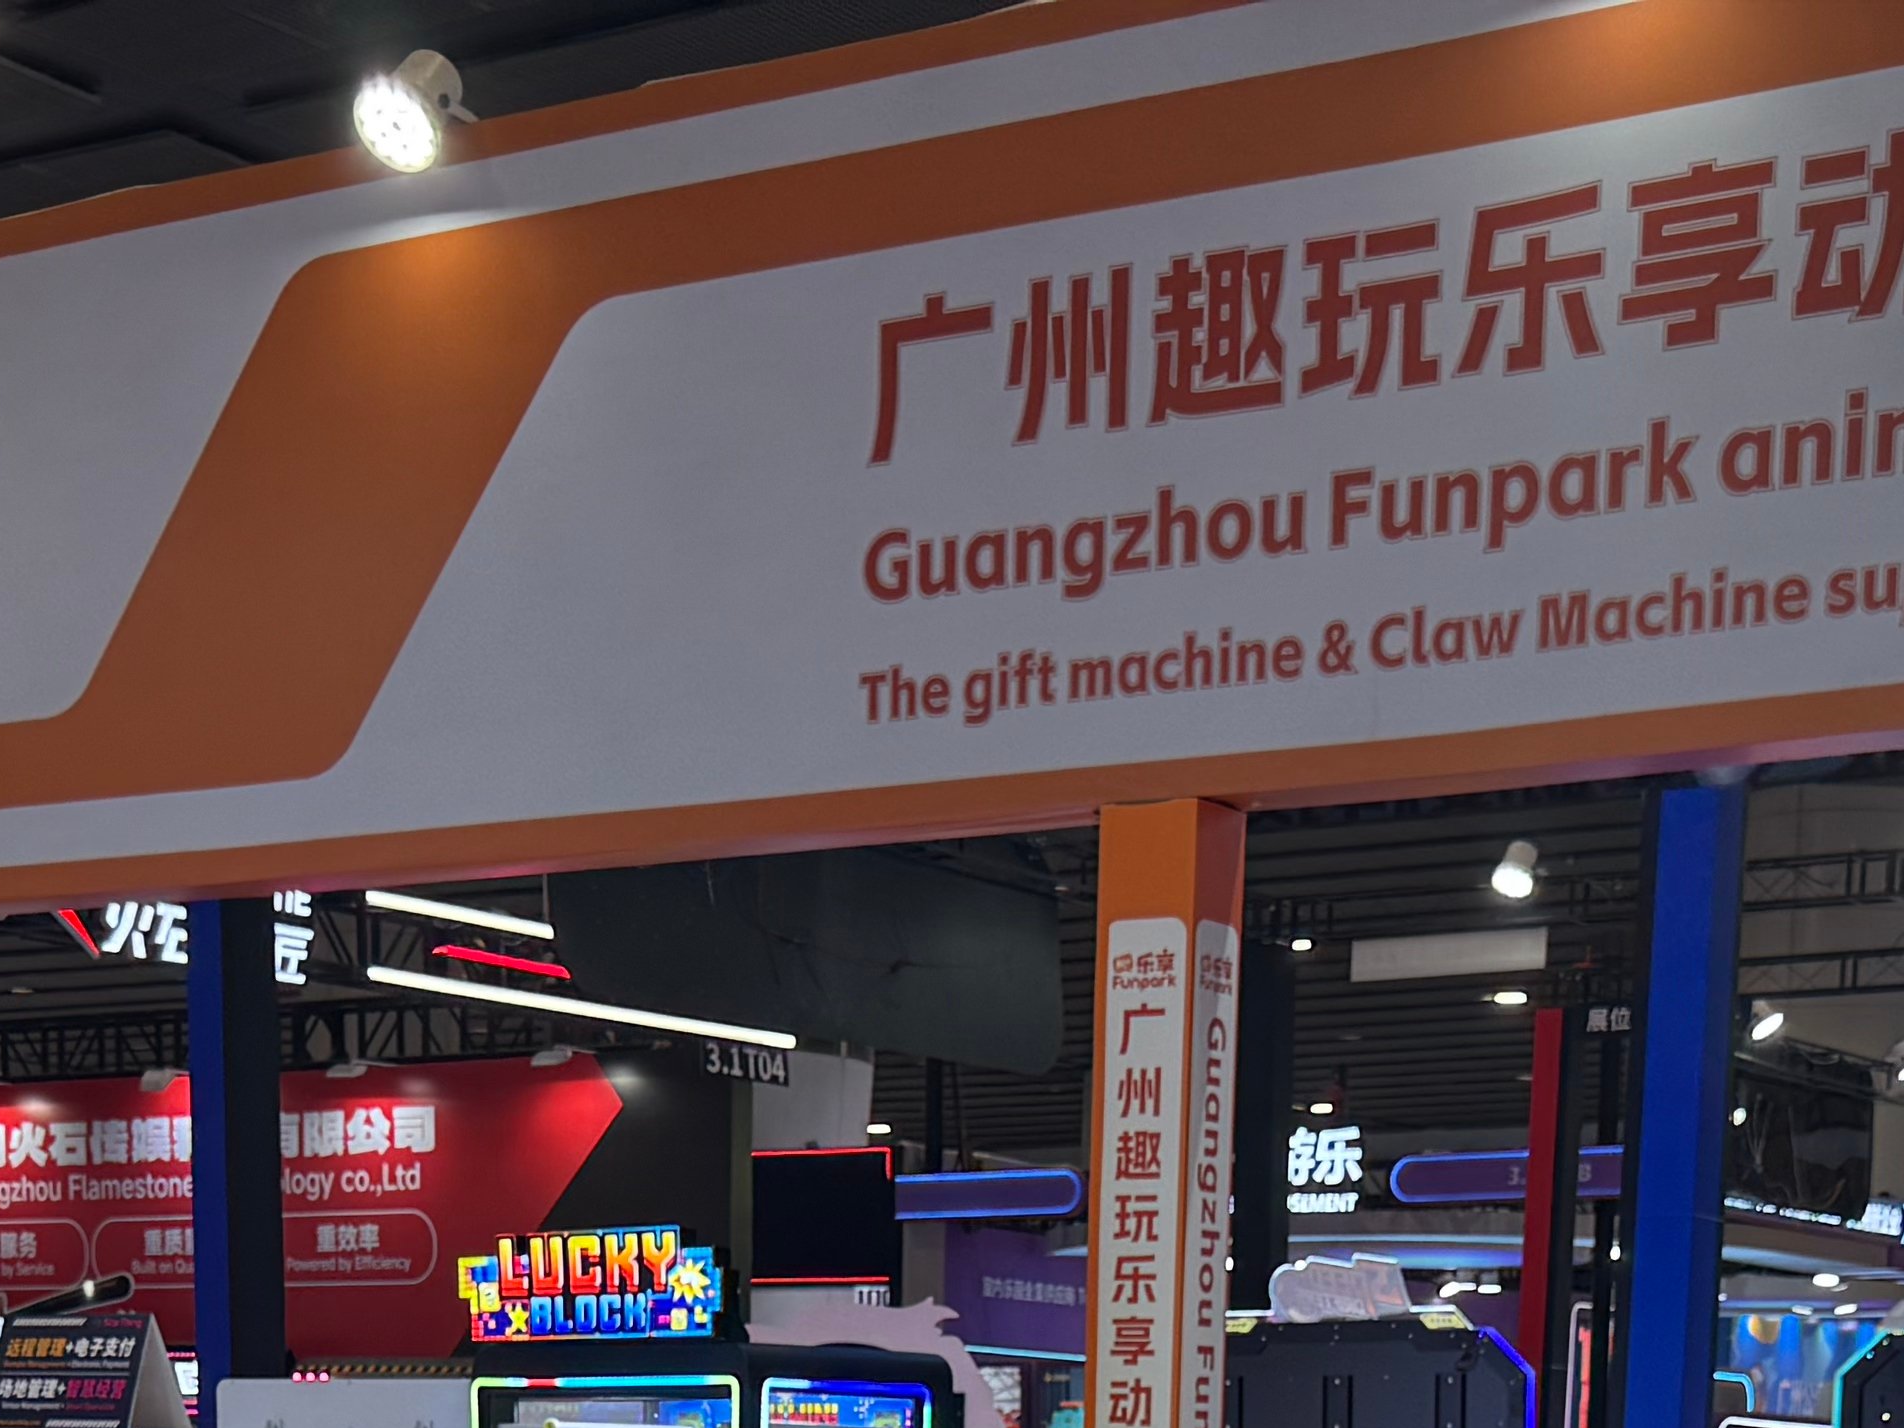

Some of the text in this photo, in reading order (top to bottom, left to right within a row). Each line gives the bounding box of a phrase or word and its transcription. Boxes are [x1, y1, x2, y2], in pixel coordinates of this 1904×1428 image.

[863, 482, 1308, 604] Guangzhou
[1329, 416, 1696, 552] Funpark
[858, 666, 949, 725] The
[961, 646, 1057, 727] gift
[1066, 607, 1303, 702] machine
[1316, 618, 1355, 674] &
[1368, 603, 1522, 671] Claw
[1536, 568, 1810, 655] Machine
[704, 1042, 789, 1085] 3.1T04
[68, 1172, 194, 1202] Flamestone
[280, 1167, 335, 1202] logy
[1197, 1016, 1228, 1329] Guangzhou
[497, 1230, 679, 1297] LUCKY
[531, 1292, 650, 1335] BLOCK
